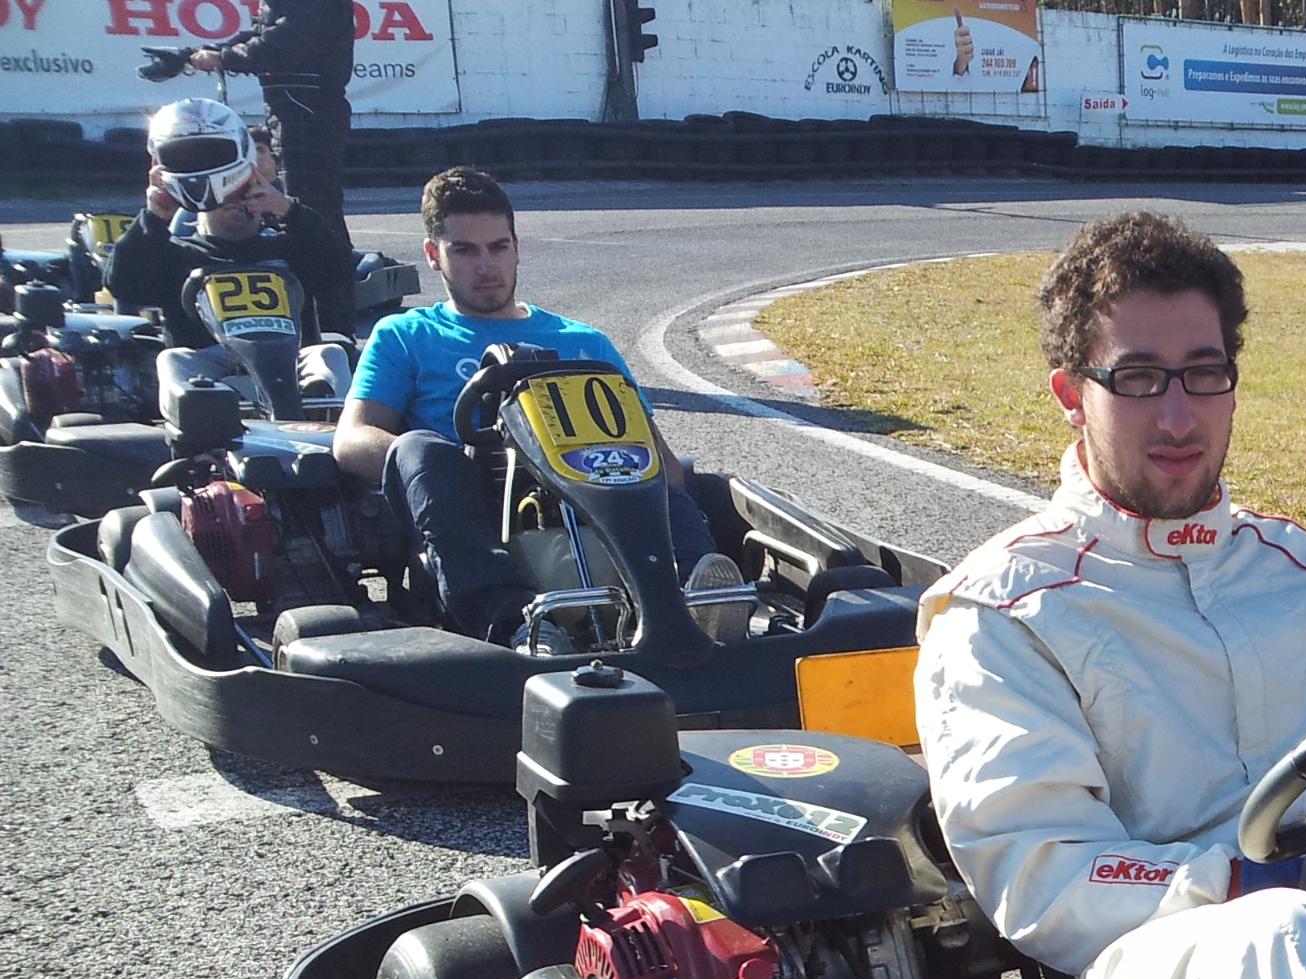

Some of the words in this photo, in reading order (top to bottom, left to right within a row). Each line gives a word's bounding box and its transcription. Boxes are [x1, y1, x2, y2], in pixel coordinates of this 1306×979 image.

[0, 50, 94, 74] exclusivo
[804, 45, 840, 92] ESCOLA
[846, 45, 888, 95] KARTING
[1188, 68, 1225, 83] Preparamos
[826, 82, 872, 95] EUROINDY
[214, 275, 279, 312] 25
[545, 377, 626, 438] 10
[786, 820, 847, 842] EUROINDY
